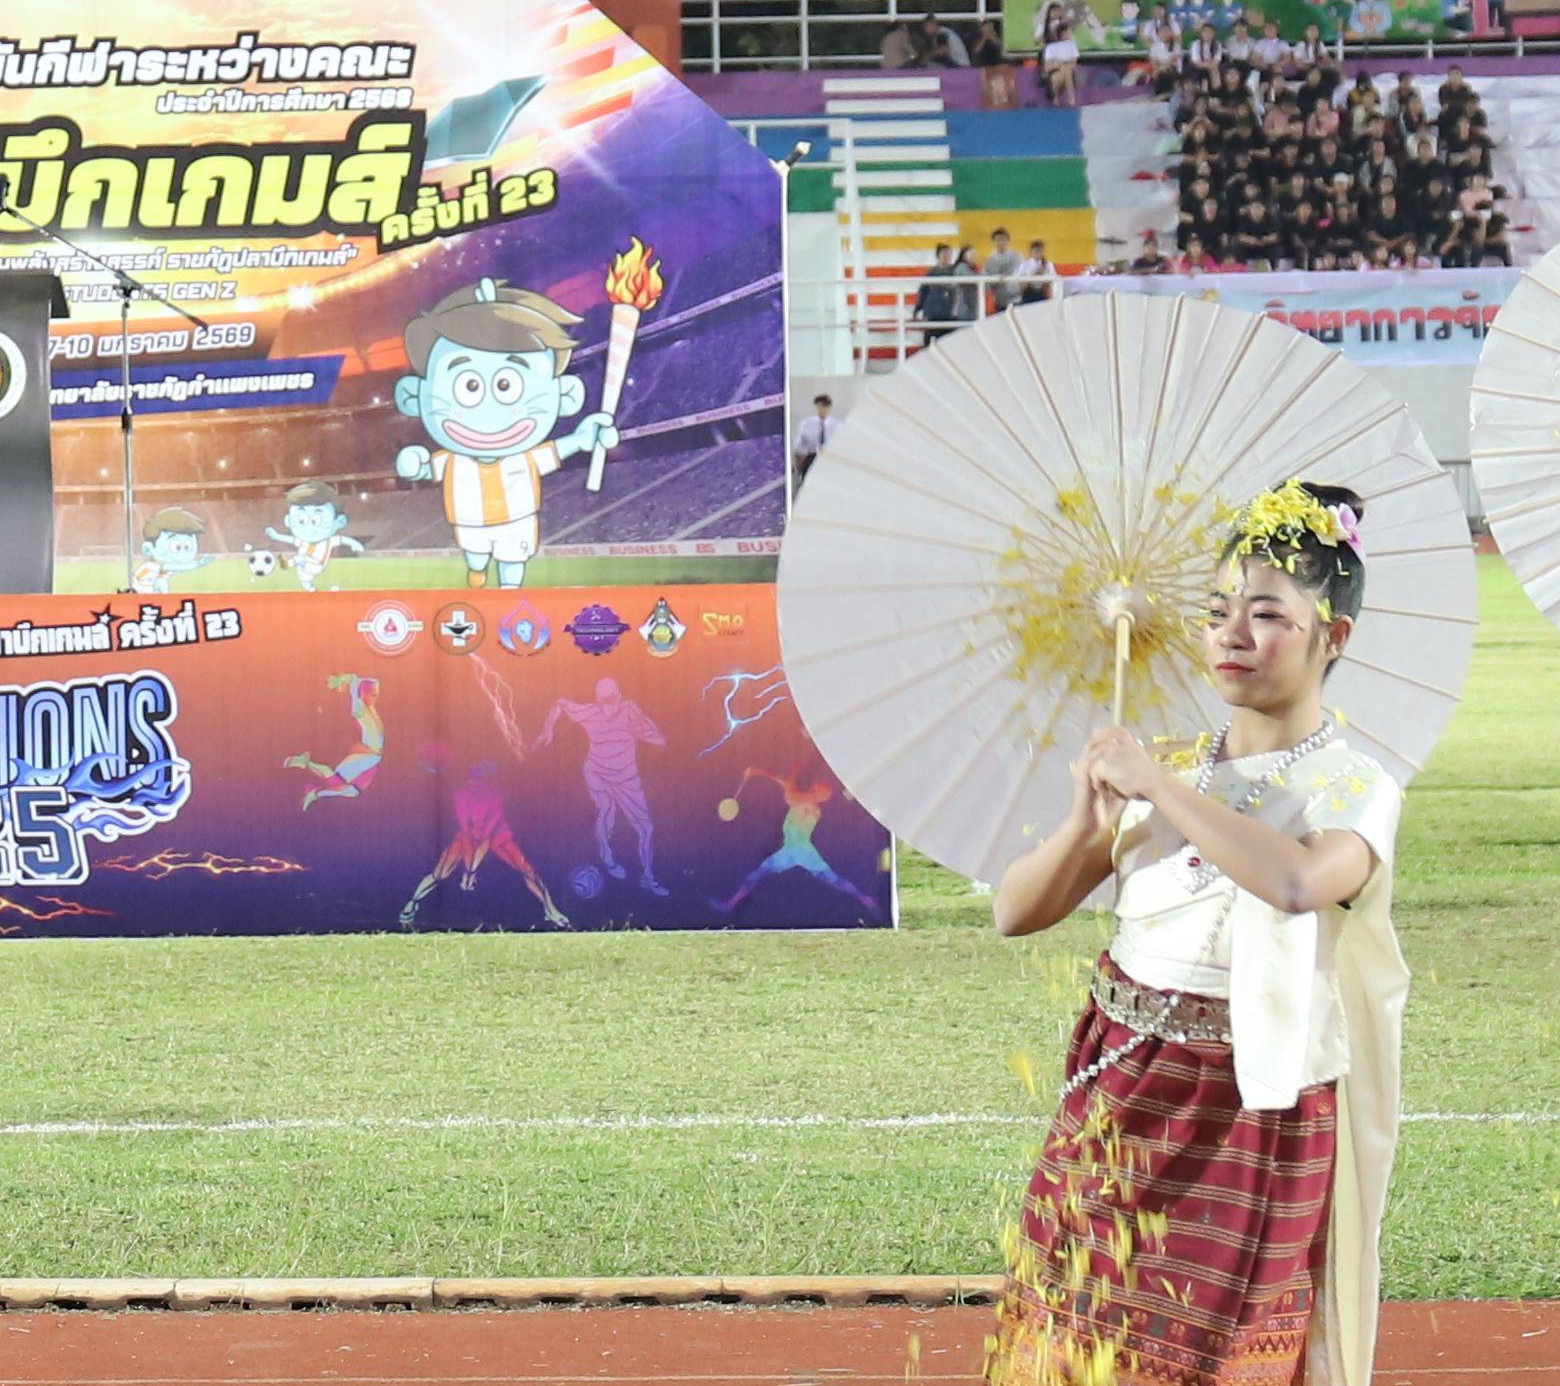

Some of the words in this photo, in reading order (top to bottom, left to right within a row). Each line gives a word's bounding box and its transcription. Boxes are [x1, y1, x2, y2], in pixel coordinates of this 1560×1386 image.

[156, 89, 346, 113] ประจำปีการศึกษา
[381, 169, 490, 245] ครั้งที่
[500, 169, 557, 213] 23
[172, 281, 218, 301] GEN
[220, 280, 238, 300] Z
[96, 328, 188, 357] มกราคม
[191, 322, 255, 350] 2569
[48, 371, 315, 406] ทยาลัยราชภัฏกำแพงเพชร
[608, 541, 678, 556] BUSINESS
[118, 599, 199, 651] ครั้งที่
[203, 608, 241, 642] 23
